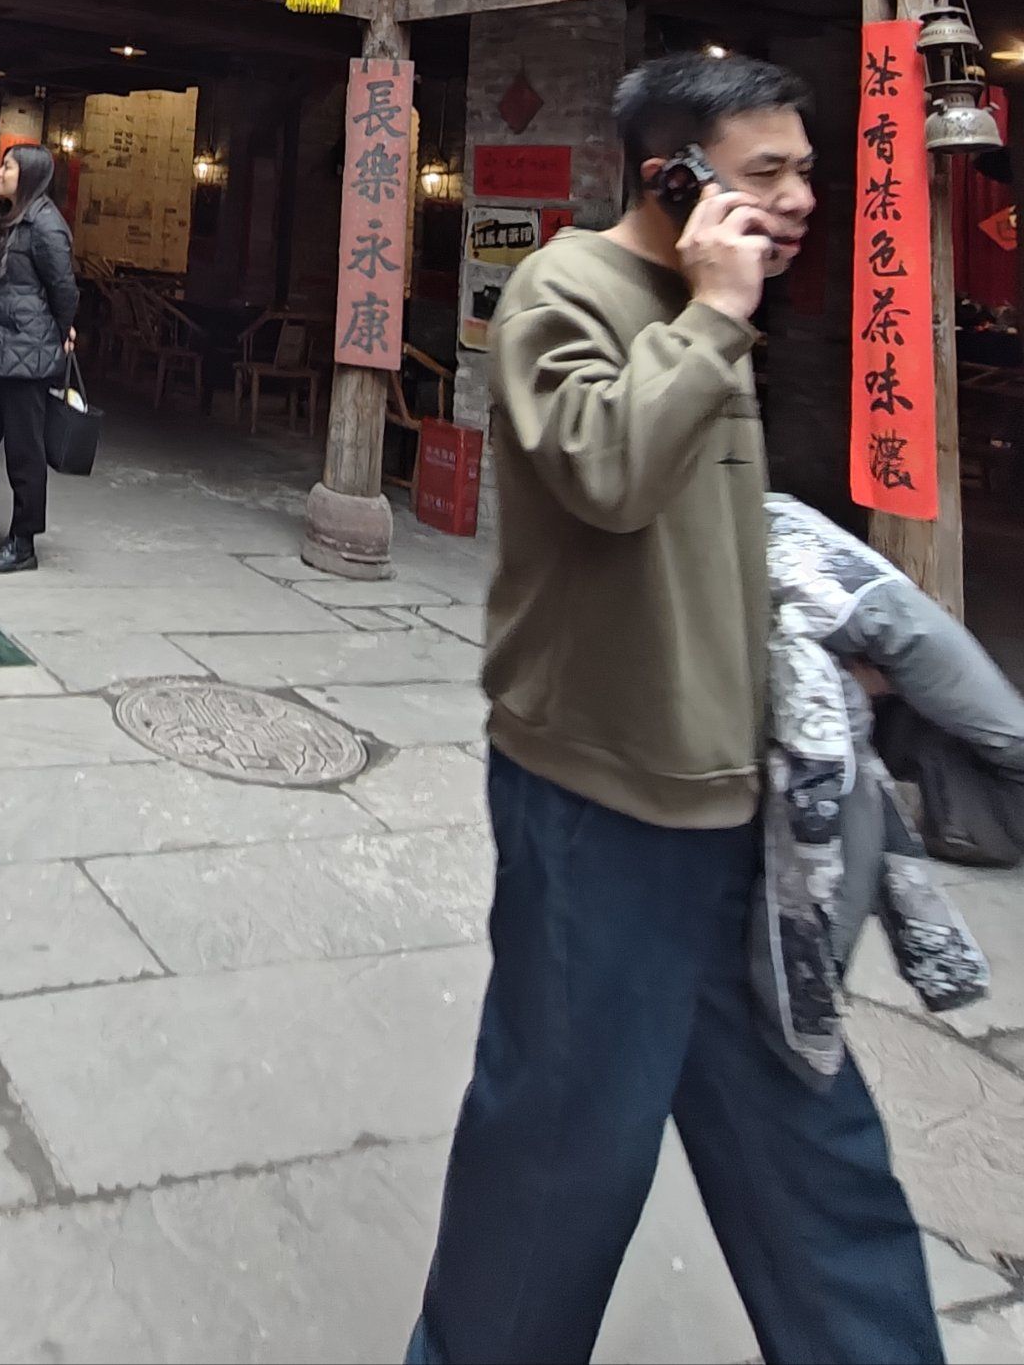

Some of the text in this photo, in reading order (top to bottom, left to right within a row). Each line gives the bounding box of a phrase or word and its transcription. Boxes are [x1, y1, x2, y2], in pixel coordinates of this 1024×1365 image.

[339, 79, 407, 354] 長樂永康
[861, 45, 916, 491] 茶香茶色茶味濃
